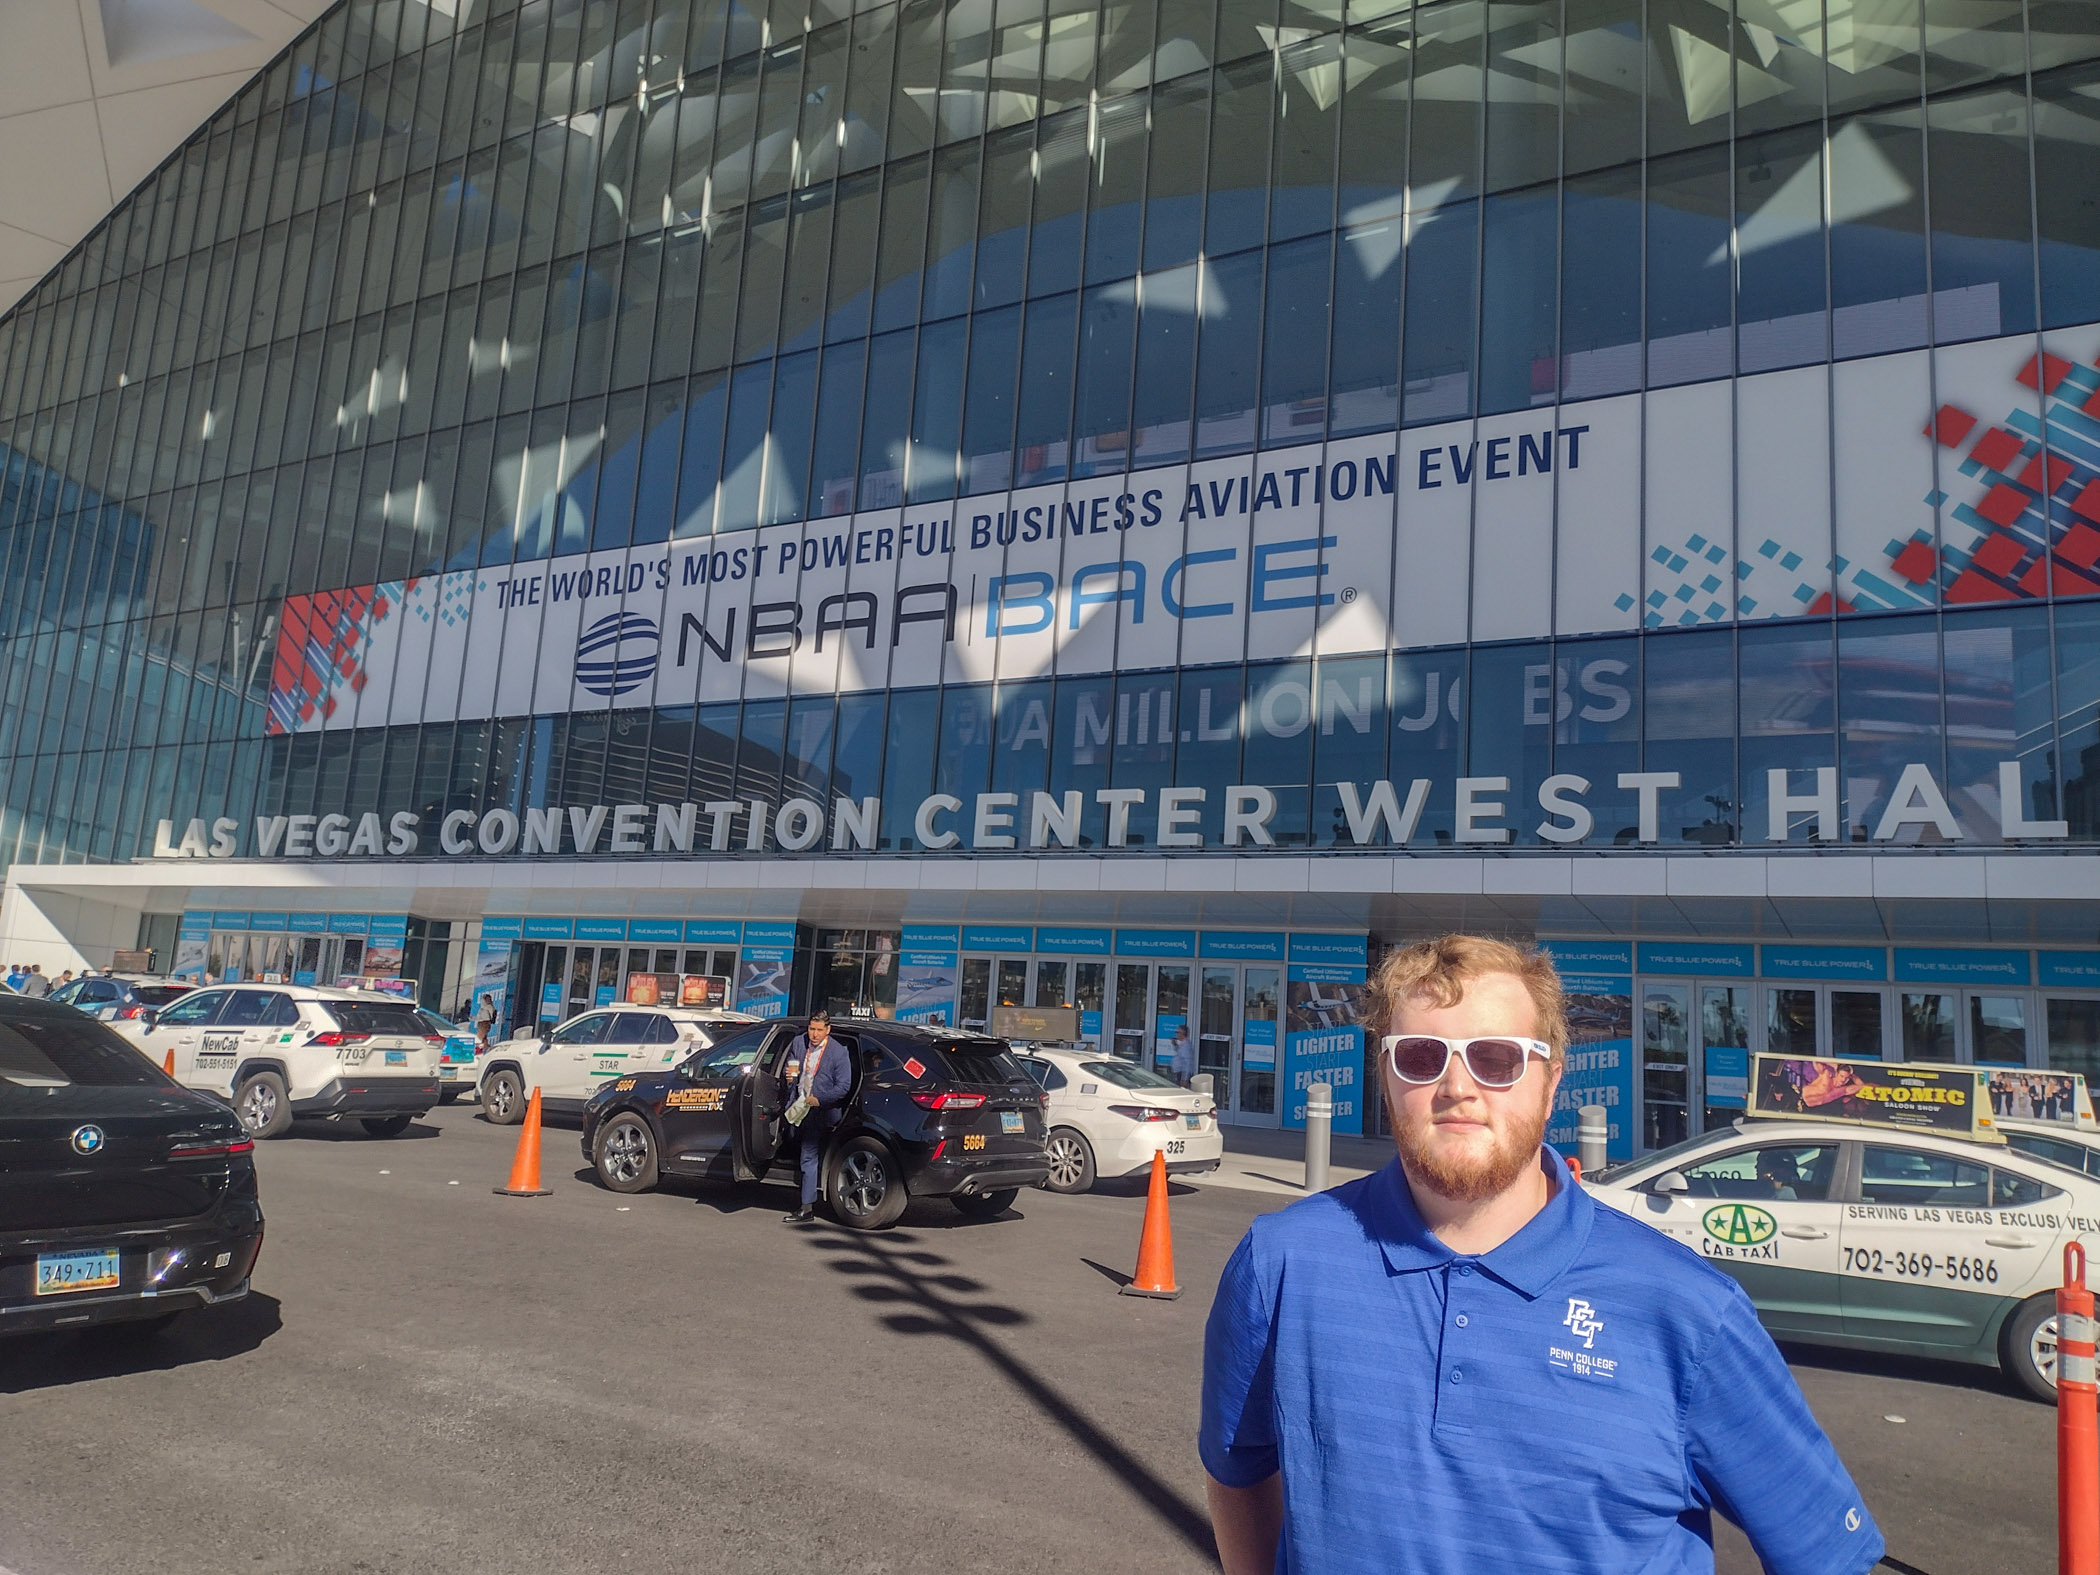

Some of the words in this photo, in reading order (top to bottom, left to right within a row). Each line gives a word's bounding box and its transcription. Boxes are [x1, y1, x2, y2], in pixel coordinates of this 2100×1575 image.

[498, 575, 541, 609] THE
[552, 558, 671, 602] WORLD'S
[683, 545, 769, 587] MOST
[779, 519, 956, 575] POWERFUL
[971, 488, 1162, 550] BUSINESS
[1179, 453, 1397, 523] AVIATION
[1419, 425, 1591, 489] EVENT
[677, 582, 958, 667] NBAA
[1011, 699, 1050, 751] A
[1074, 676, 1373, 748] MILLON
[154, 817, 238, 858] LAS
[256, 811, 420, 857] VEGAS
[441, 796, 881, 856] CONVENTION
[914, 784, 1277, 849] CENTER
[1335, 771, 1682, 847] WEST
[1767, 760, 2069, 842] HAL
[1774, 959, 1800, 967] TRUE
[2054, 966, 2084, 974] TRUE
[851, 1007, 870, 1017] TAXI
[201, 1036, 239, 1051] NewCab
[1296, 1034, 1354, 1056] LIGHTER
[336, 1048, 366, 1060] 7703
[1306, 1052, 1342, 1071] START
[1565, 1050, 1619, 1072] GHTER
[196, 1058, 237, 1070] 702-551-5151
[599, 1060, 619, 1070] STAR
[1294, 1066, 1353, 1090] FASTER
[666, 1088, 721, 1103] HENDERSON
[1856, 1085, 1965, 1106] ATOMIC
[1294, 1101, 1352, 1120] STER
[1884, 1102, 1915, 1110] SALOON
[1917, 1104, 1941, 1112] SHOW
[964, 1135, 985, 1150] 5664
[1549, 1124, 1619, 1144] SMAER
[1166, 1141, 1185, 1154] 325
[1848, 1206, 1908, 1220] SERVING
[1914, 1209, 1940, 1222] LAS
[1946, 1210, 1993, 1225] VEGAS
[1703, 1238, 1734, 1256] CAB
[1741, 1240, 1778, 1259] TAXI
[1844, 1247, 1998, 1284] 702-369-5686
[1550, 1347, 1574, 1361] PENN
[1572, 1363, 1591, 1376] 1914
